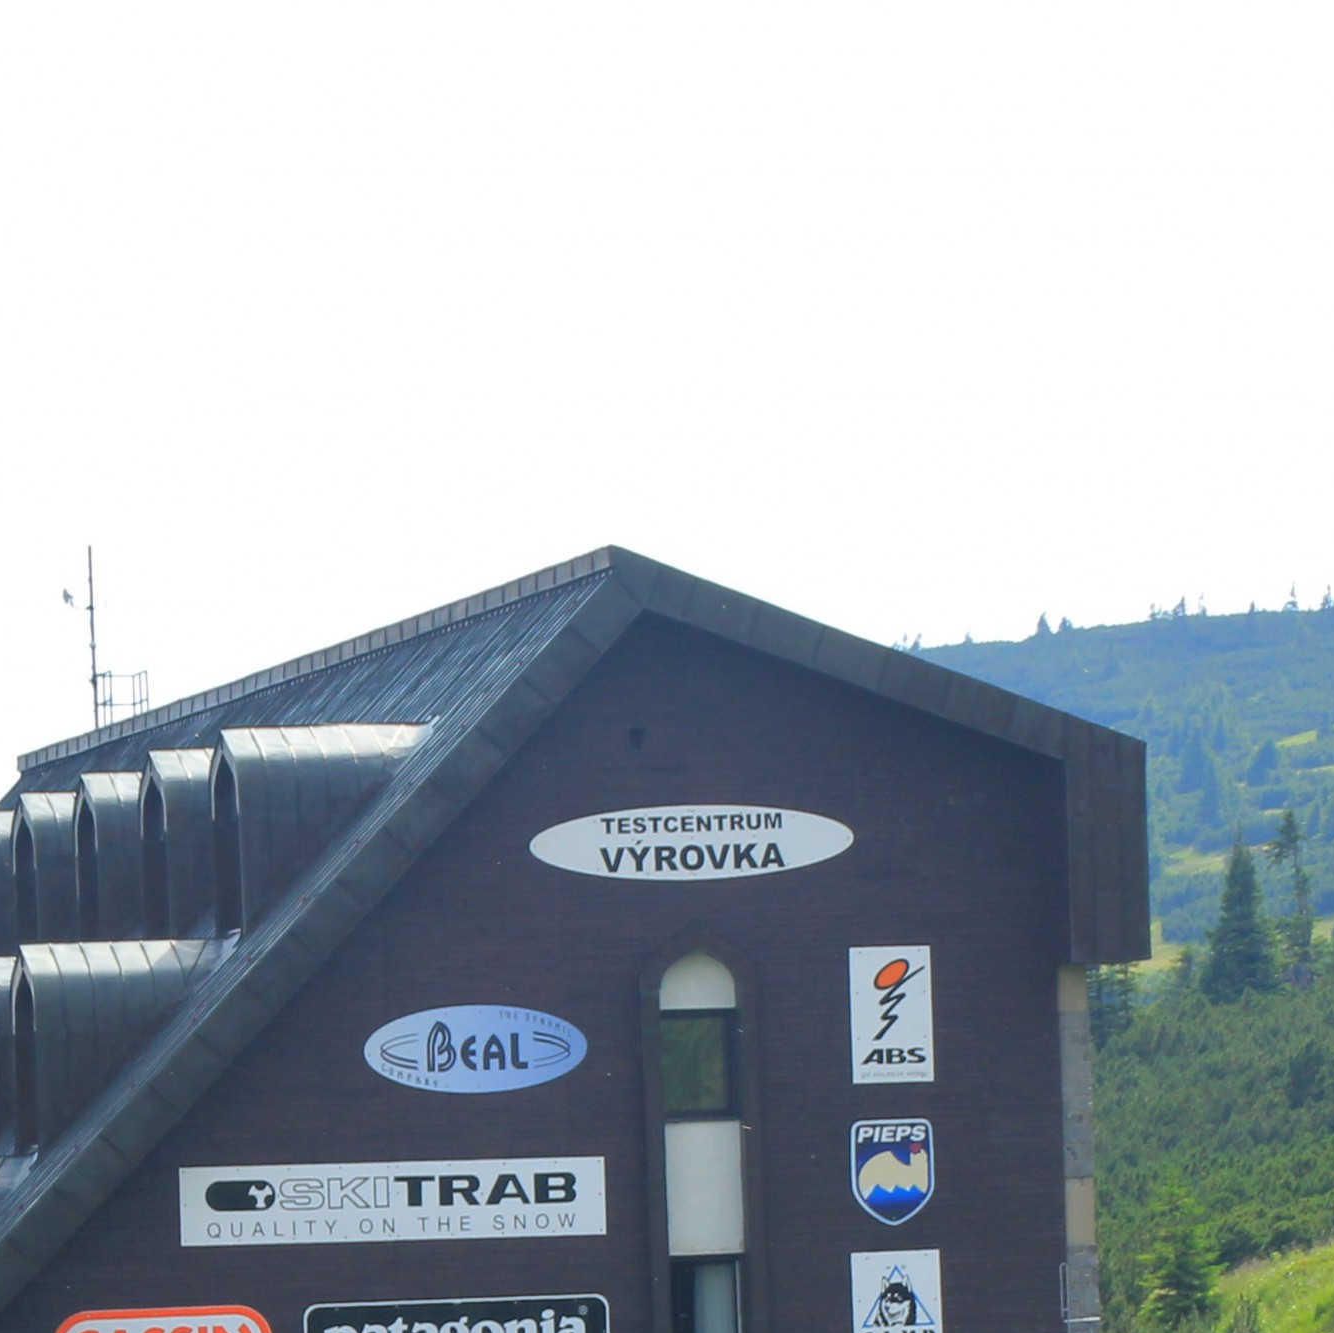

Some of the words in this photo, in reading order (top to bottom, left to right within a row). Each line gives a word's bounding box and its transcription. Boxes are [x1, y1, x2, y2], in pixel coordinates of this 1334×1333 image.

[600, 812, 783, 835] TESTCENTRUM
[600, 840, 786, 873] VÝROVKA
[426, 1020, 529, 1073] BEAL
[861, 1047, 927, 1065] ABS
[857, 1125, 927, 1144] PIEPS
[279, 1171, 578, 1211] SKITRAB
[206, 1218, 338, 1240] QUALITY
[358, 1217, 396, 1235] ON
[418, 1215, 472, 1233] THE
[492, 1212, 578, 1231] SNOW
